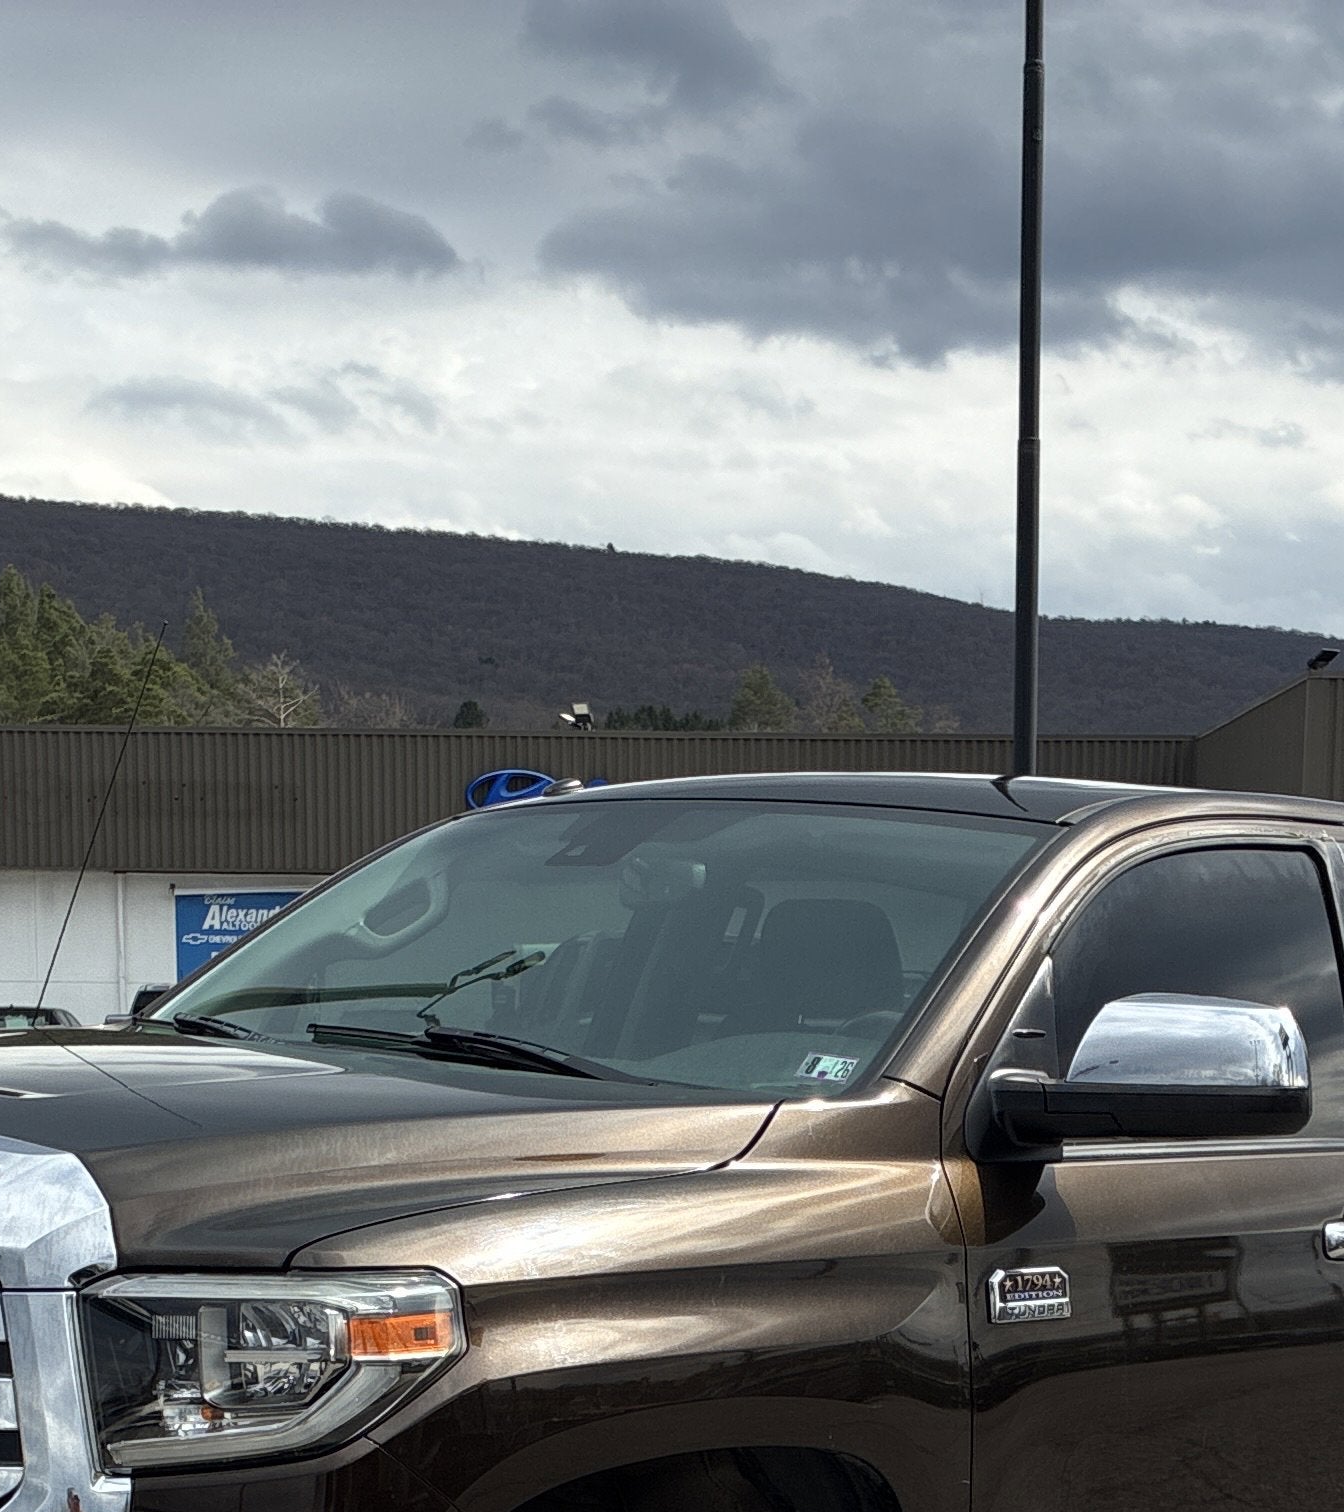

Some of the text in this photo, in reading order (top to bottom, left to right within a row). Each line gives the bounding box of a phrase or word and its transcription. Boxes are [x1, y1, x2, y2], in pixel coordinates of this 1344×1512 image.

[202, 904, 281, 930] Alexand
[805, 1057, 854, 1078] 8 26
[1015, 1273, 1052, 1291] 1794
[1006, 1289, 1063, 1301] EDITION
